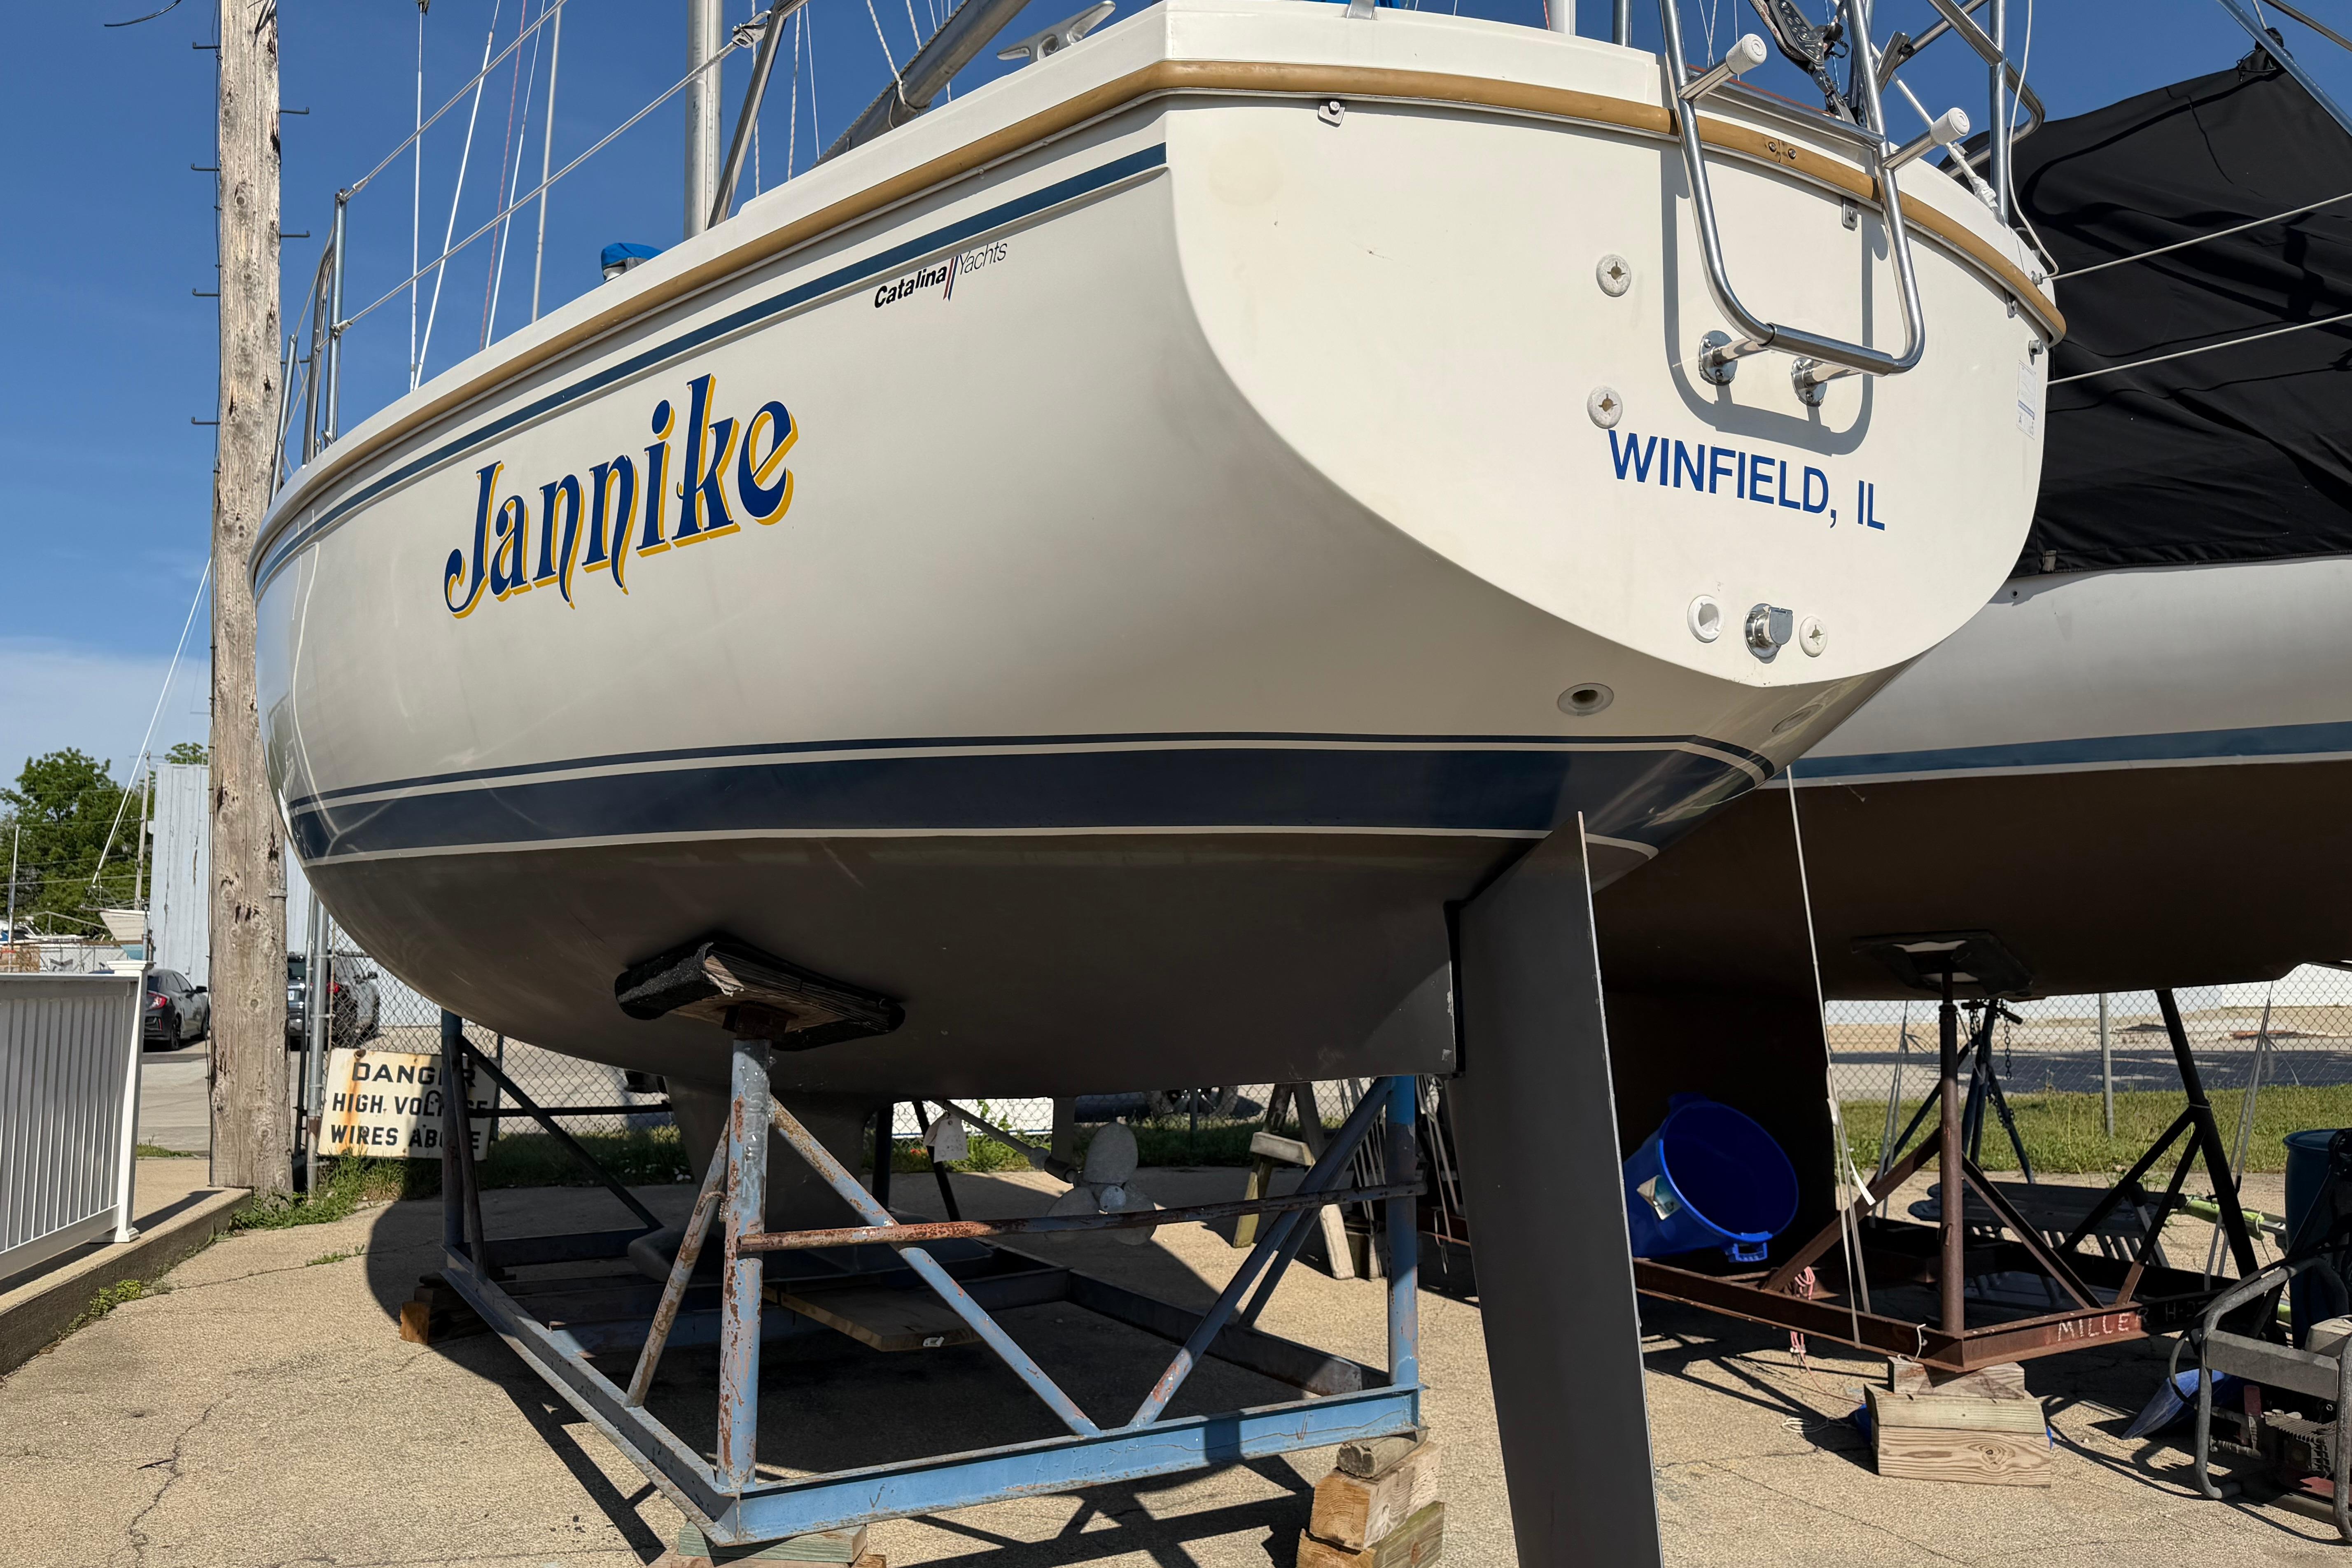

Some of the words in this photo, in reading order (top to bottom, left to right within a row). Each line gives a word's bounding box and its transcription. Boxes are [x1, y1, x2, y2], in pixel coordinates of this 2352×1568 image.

[874, 266, 947, 308] Catalina
[959, 242, 1008, 275] Yachts
[444, 373, 798, 619] Jannike
[1608, 429, 1836, 529] WINFIELD,
[1857, 480, 1885, 531] IL
[352, 1062, 476, 1087] DANGR
[332, 1092, 383, 1113] HIGH
[331, 1124, 399, 1146] WIRES
[408, 1128, 481, 1150] ABE
[2057, 1307, 2149, 1342] MILLER
